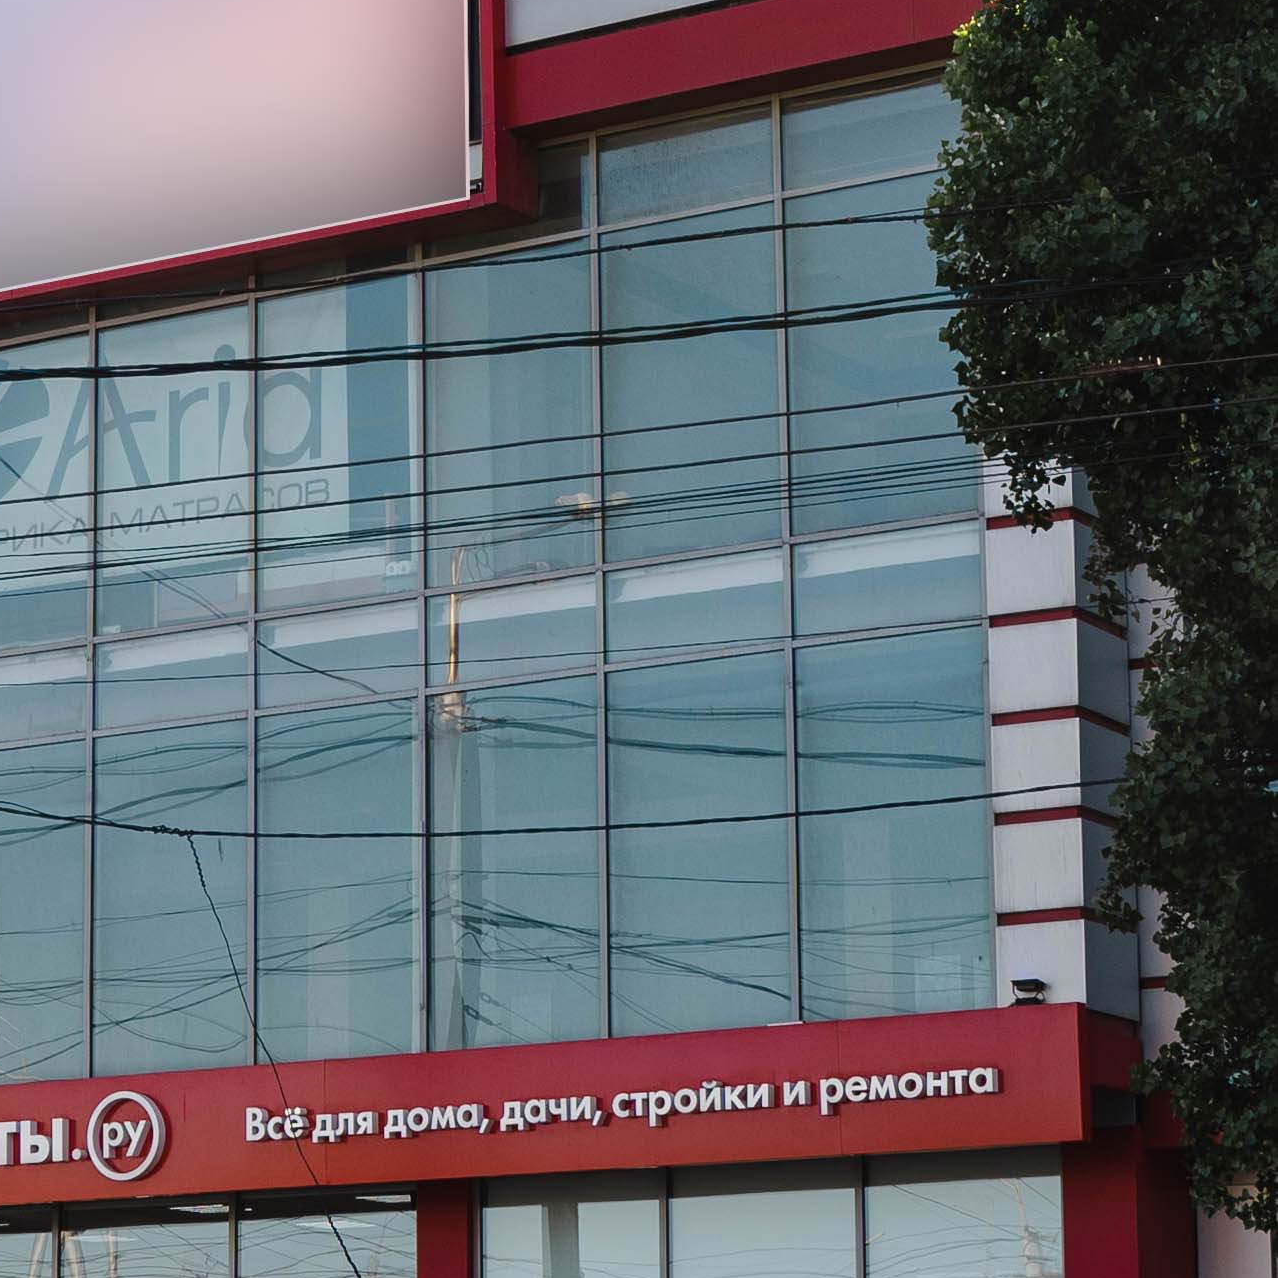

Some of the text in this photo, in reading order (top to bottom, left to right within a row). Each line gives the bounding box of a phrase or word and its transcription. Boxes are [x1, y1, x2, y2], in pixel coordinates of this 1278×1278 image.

[43, 342, 322, 498] Aria
[110, 478, 330, 538] МАТРАСОВ
[245, 1066, 1003, 1143] Всё для дома, дачи, стройки и ремонта
